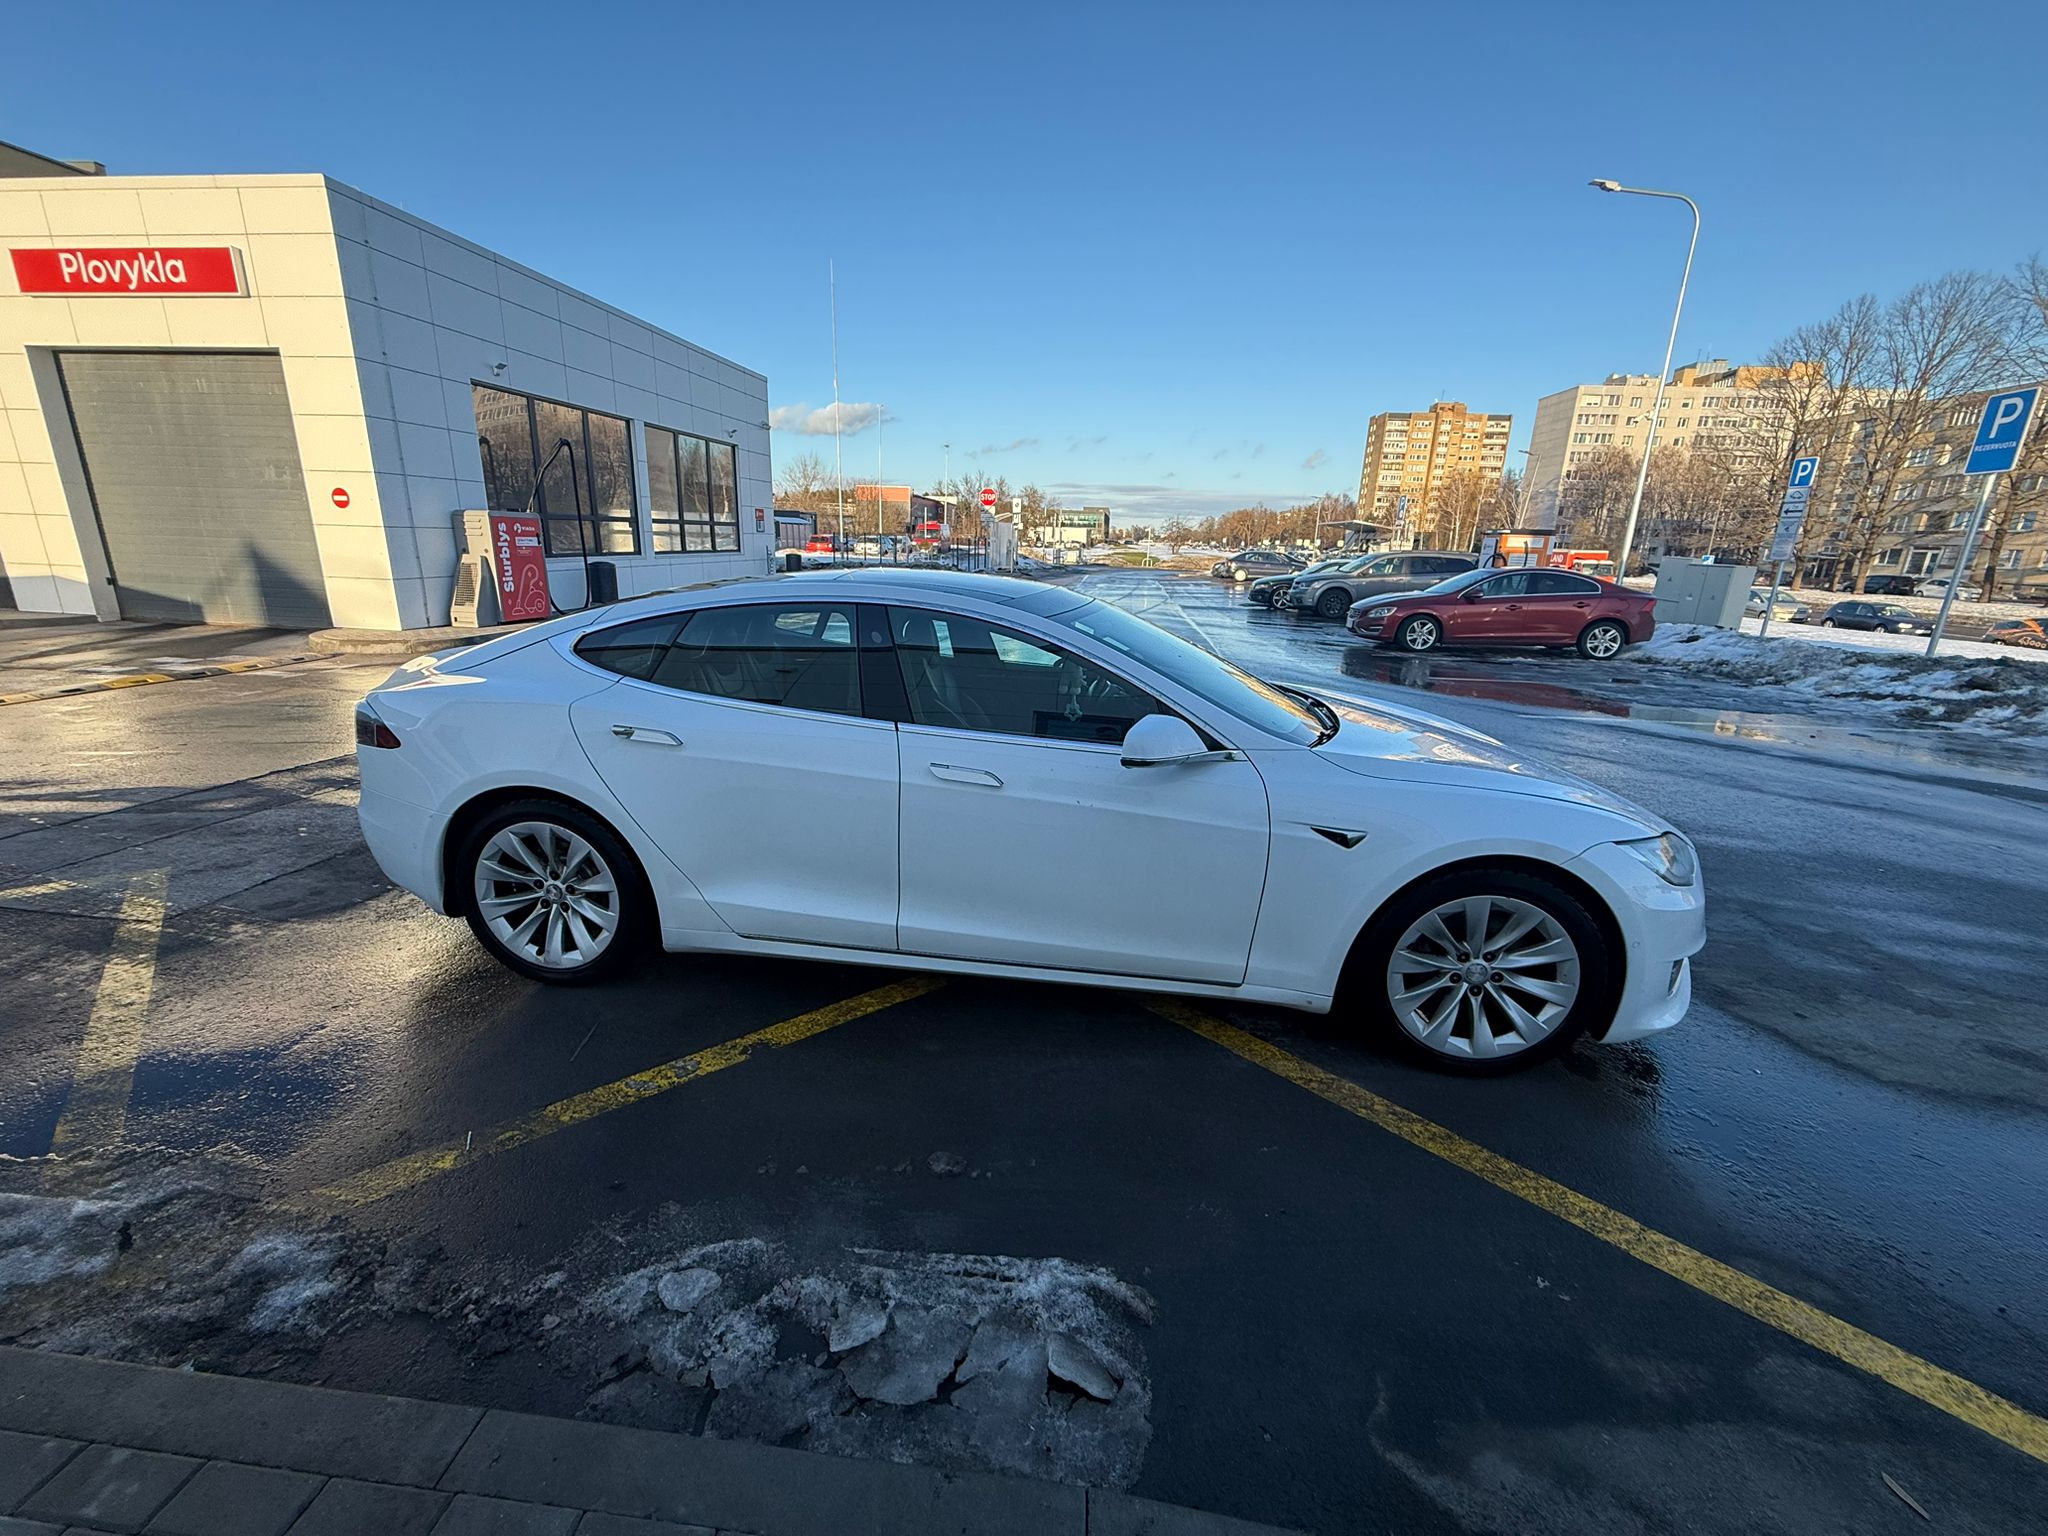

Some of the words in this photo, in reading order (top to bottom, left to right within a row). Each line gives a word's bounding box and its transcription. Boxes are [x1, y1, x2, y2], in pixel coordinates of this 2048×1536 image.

[58, 251, 188, 290] Plovykla
[1988, 397, 2024, 439] P
[1794, 461, 1812, 485] P
[980, 493, 996, 501] STOP
[498, 522, 515, 593] Siurblys
